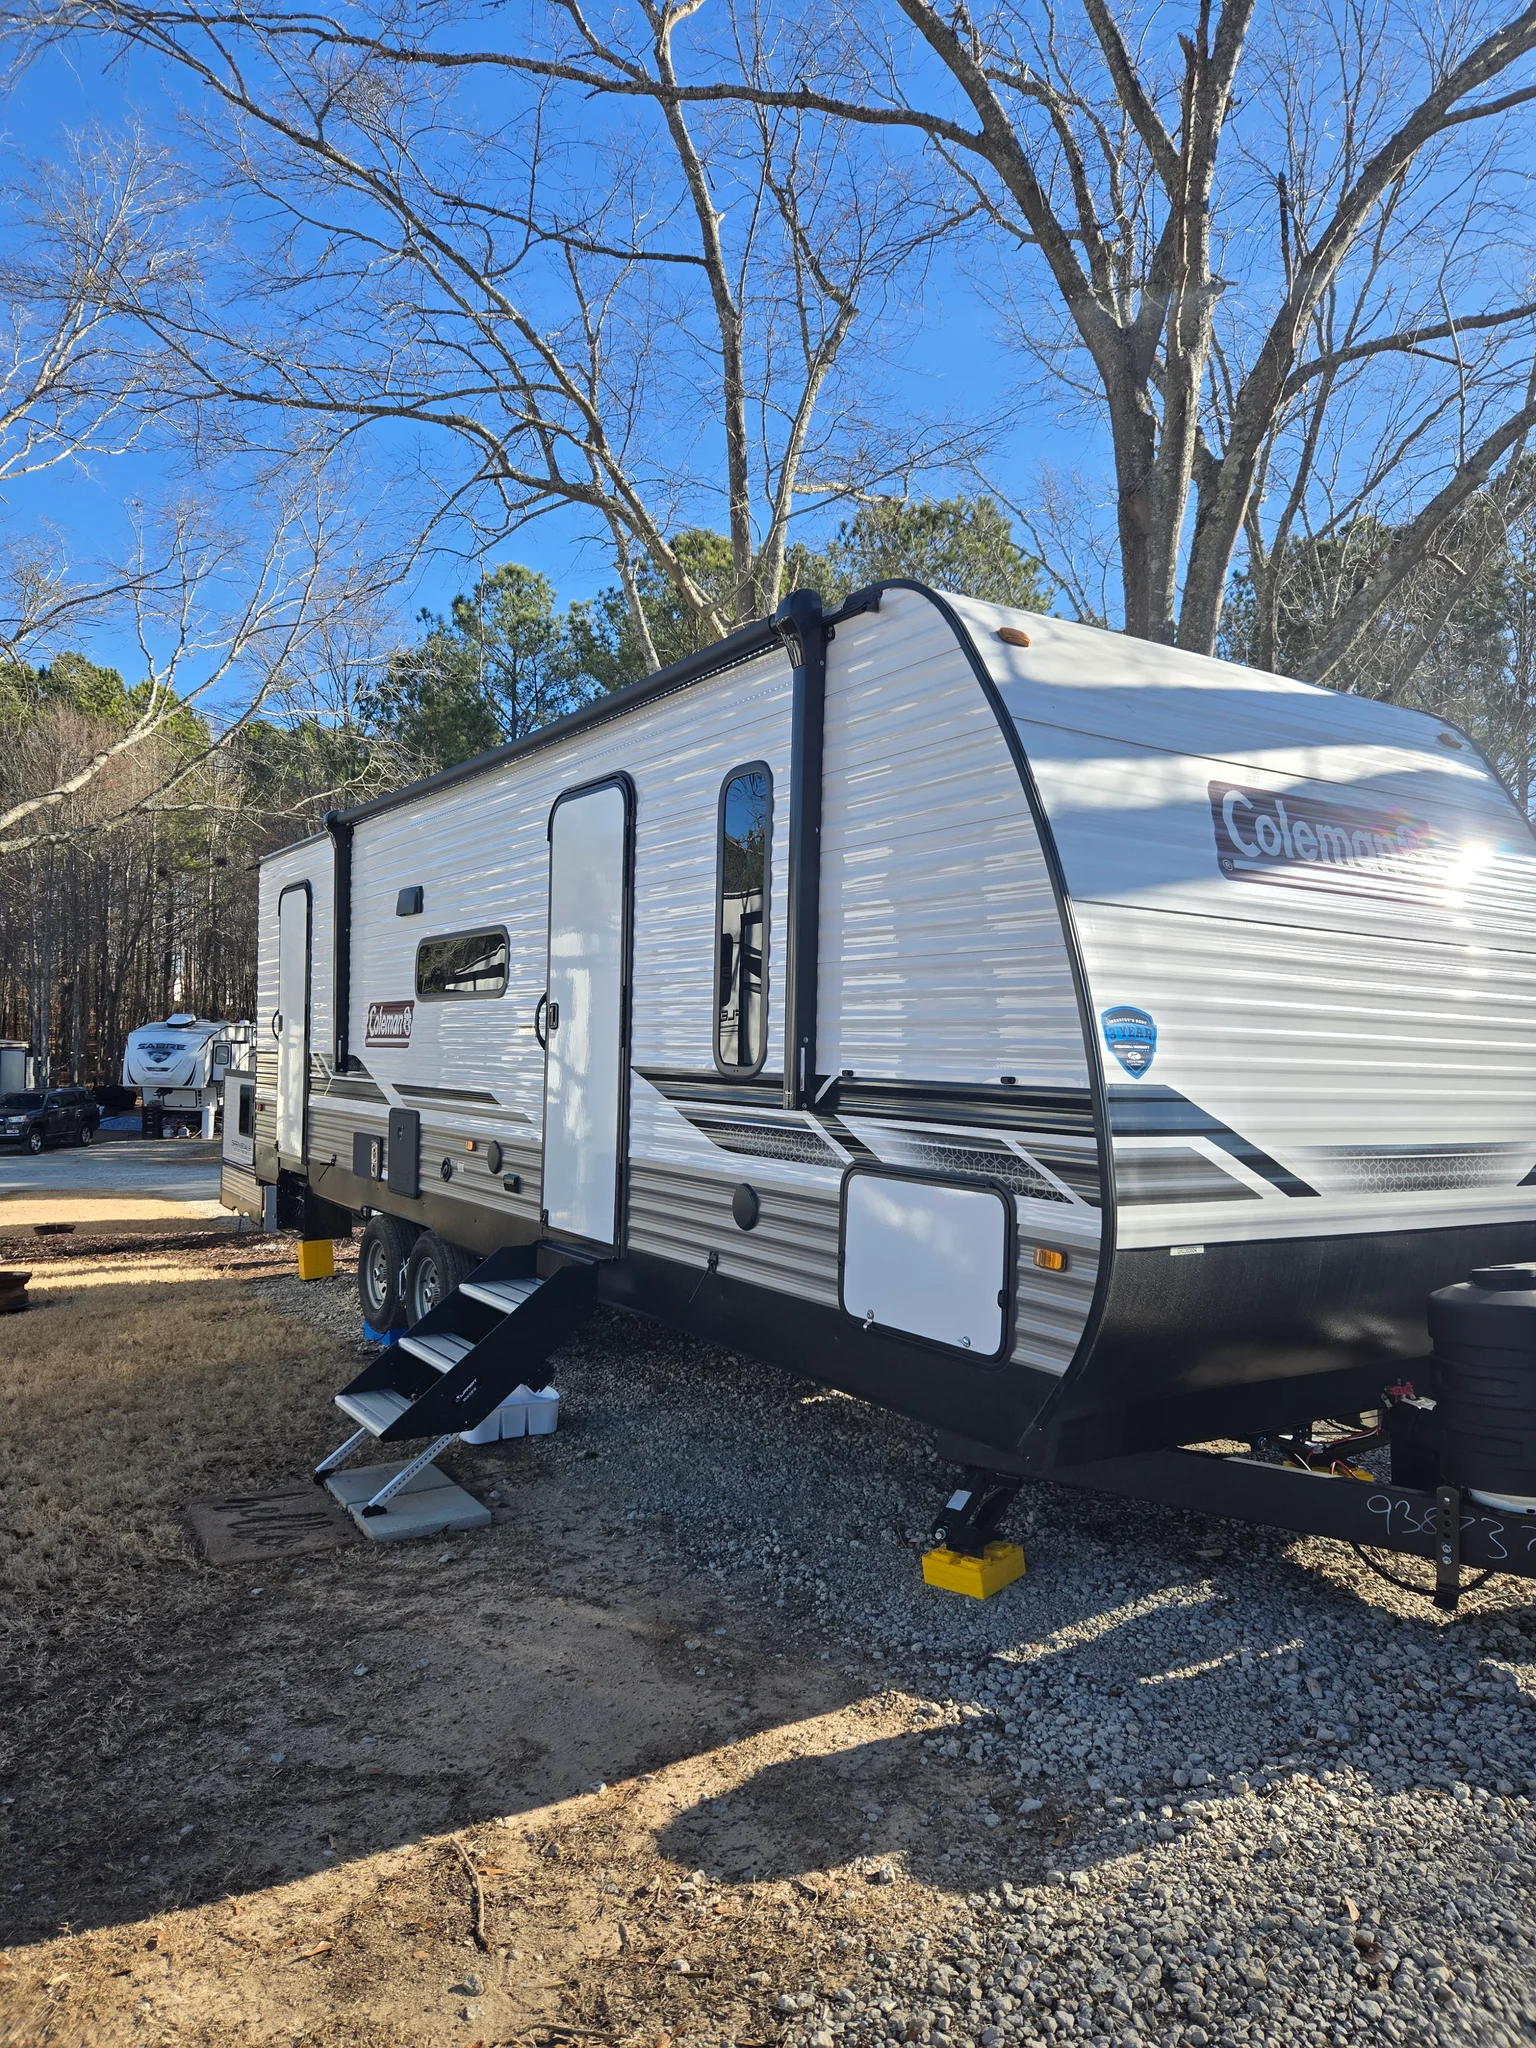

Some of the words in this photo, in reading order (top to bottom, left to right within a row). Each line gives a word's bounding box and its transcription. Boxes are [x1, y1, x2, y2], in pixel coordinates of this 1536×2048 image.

[1222, 789, 1403, 875] Coleman
[369, 1005, 403, 1037] Coleman
[1109, 1027, 1117, 1040] 3
[1120, 1026, 1153, 1040] YEAR
[136, 1043, 187, 1051] SABRE
